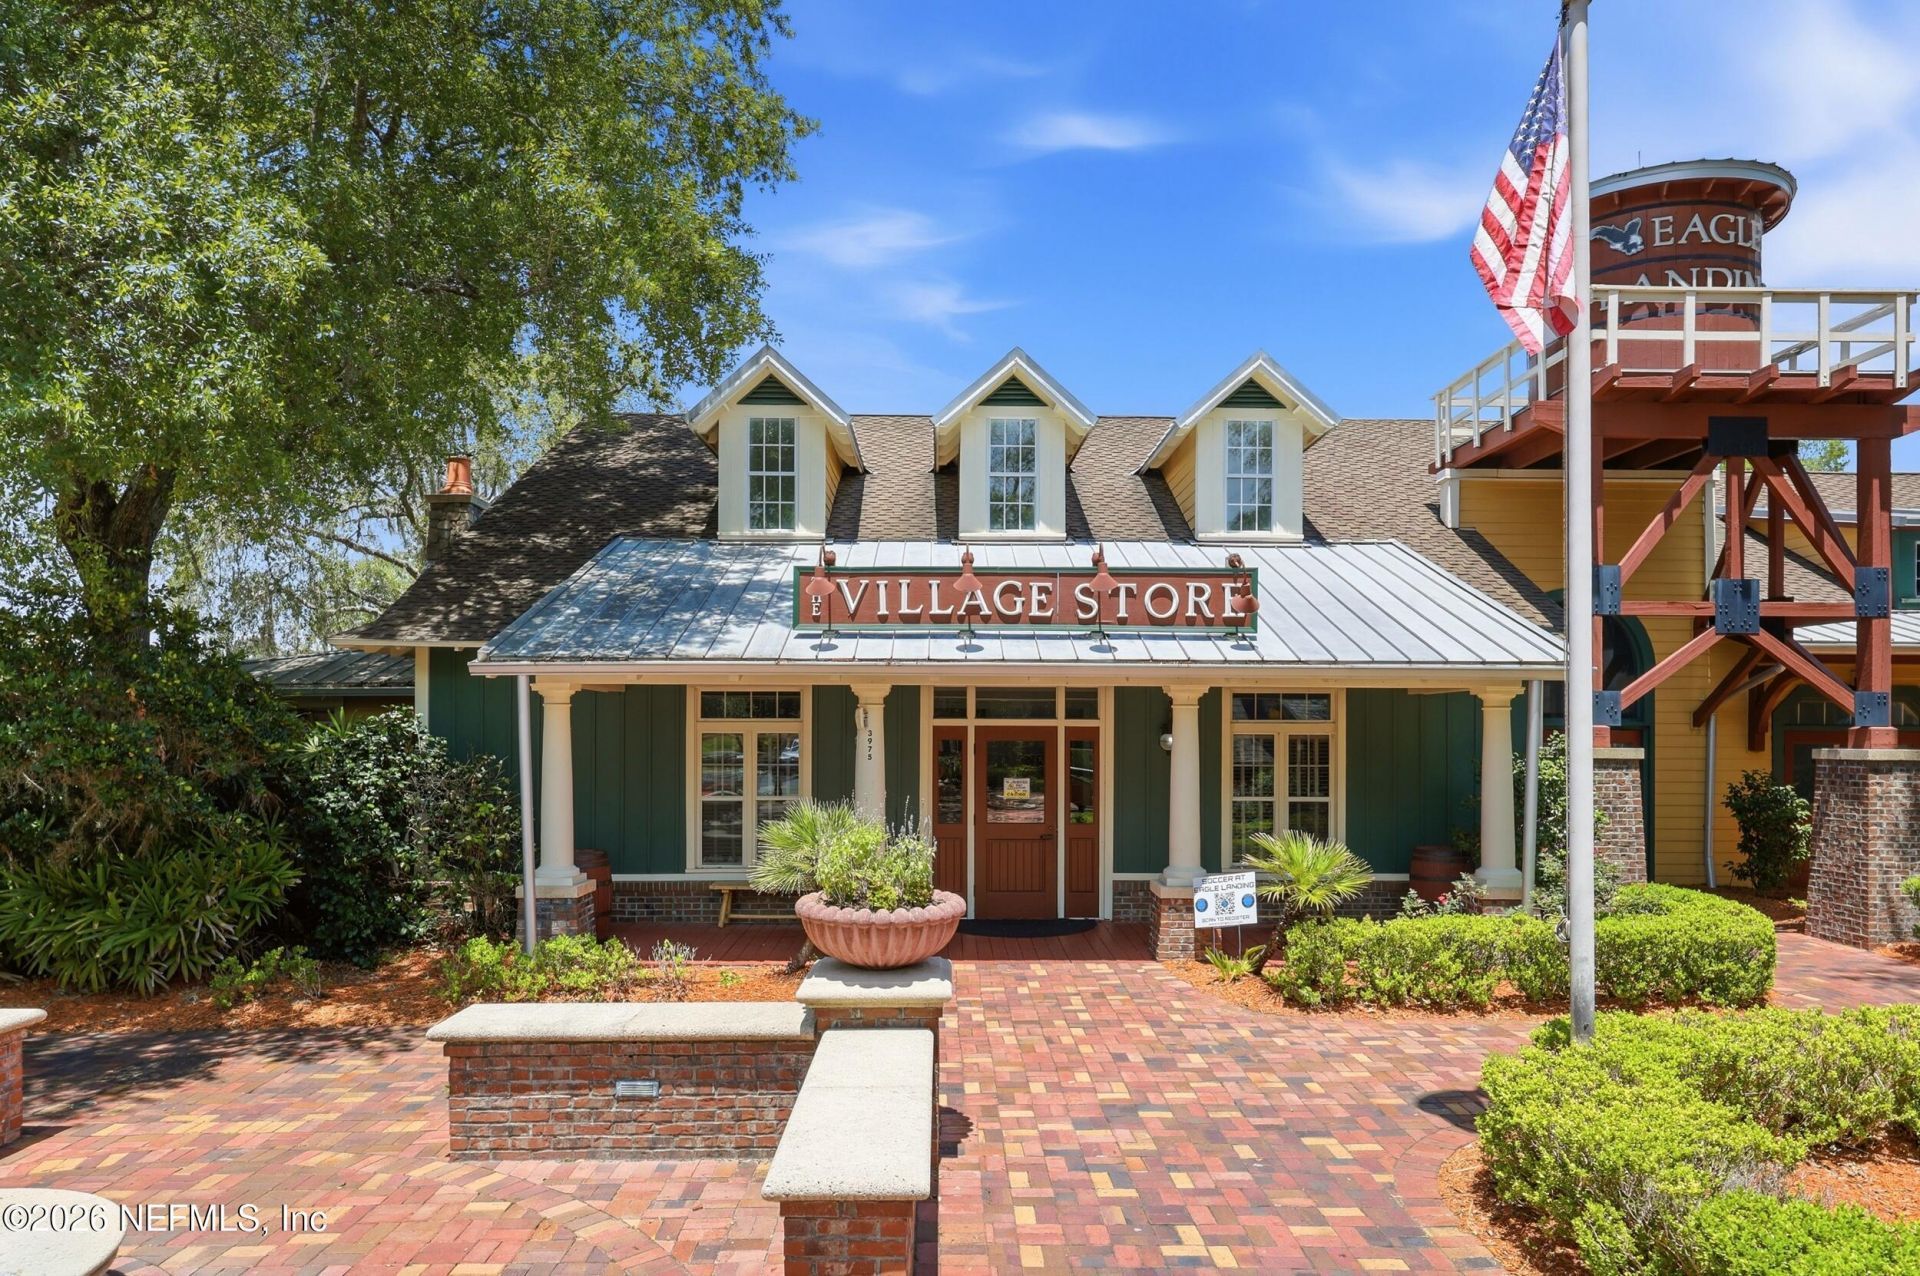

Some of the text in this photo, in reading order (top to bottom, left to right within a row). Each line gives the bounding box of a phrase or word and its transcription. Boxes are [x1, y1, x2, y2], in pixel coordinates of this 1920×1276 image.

[1651, 213, 1762, 252] EAGLE
[810, 576, 822, 616] HE
[836, 579, 1246, 619] VILLAGE STORE
[1193, 882, 1254, 893] EAGLE LANDING
[1202, 876, 1234, 884] SOCCER
